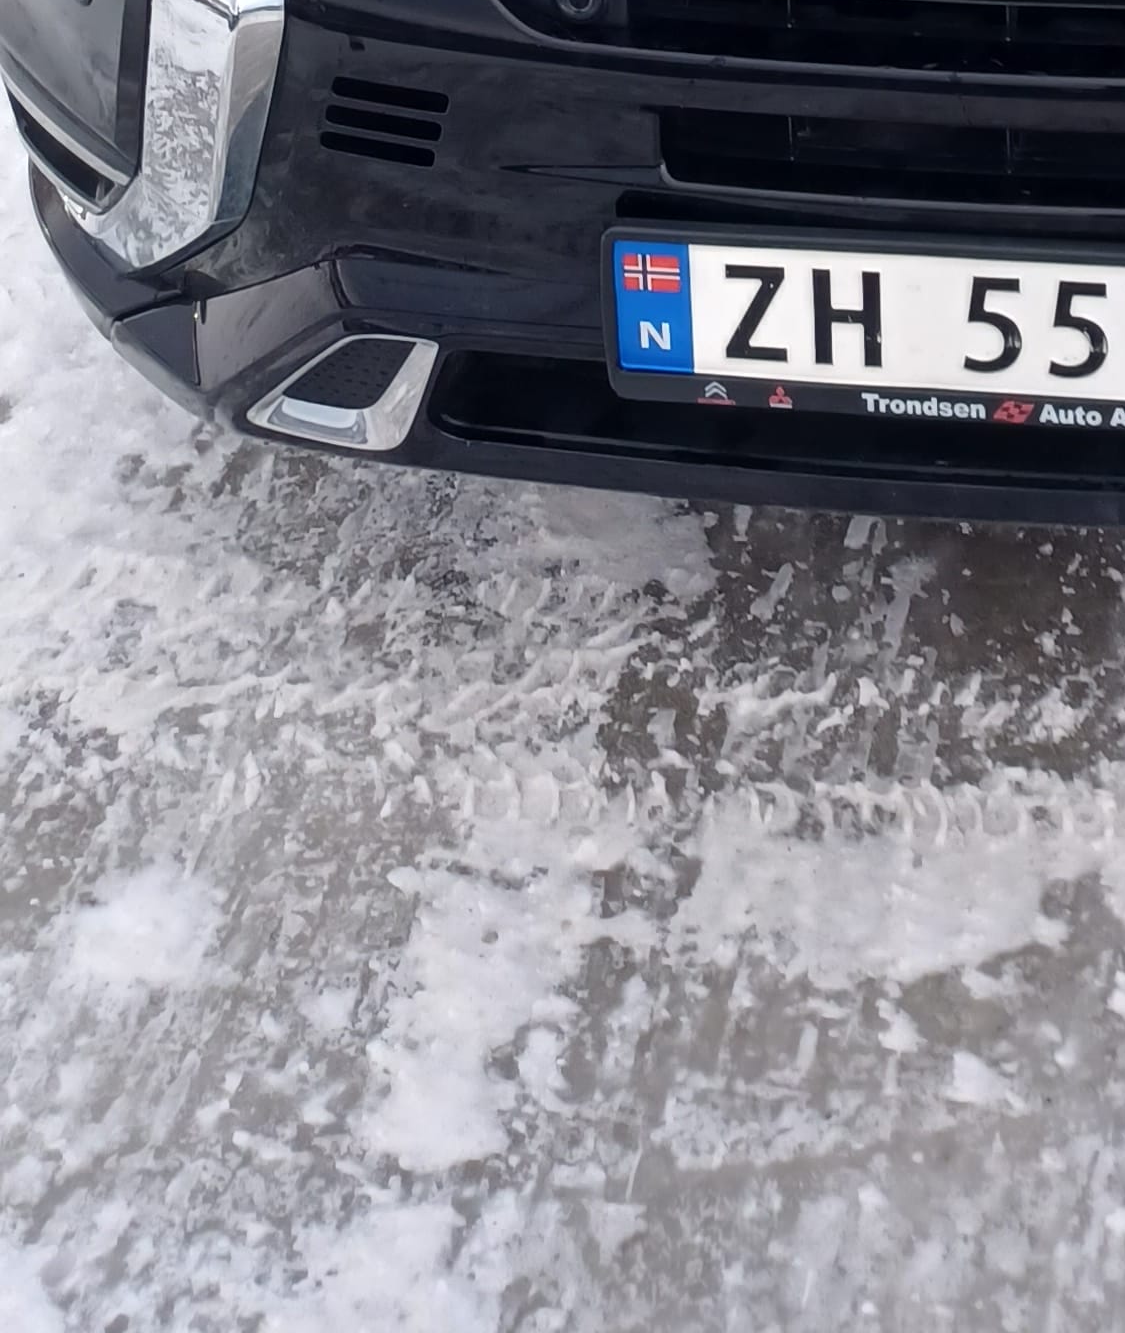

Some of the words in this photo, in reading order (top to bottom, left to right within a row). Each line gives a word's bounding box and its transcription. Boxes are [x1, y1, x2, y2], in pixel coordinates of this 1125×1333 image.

[725, 264, 883, 368] ZH
[639, 321, 671, 350] N
[861, 392, 987, 419] Trondsen
[1039, 403, 1102, 427] Auto
